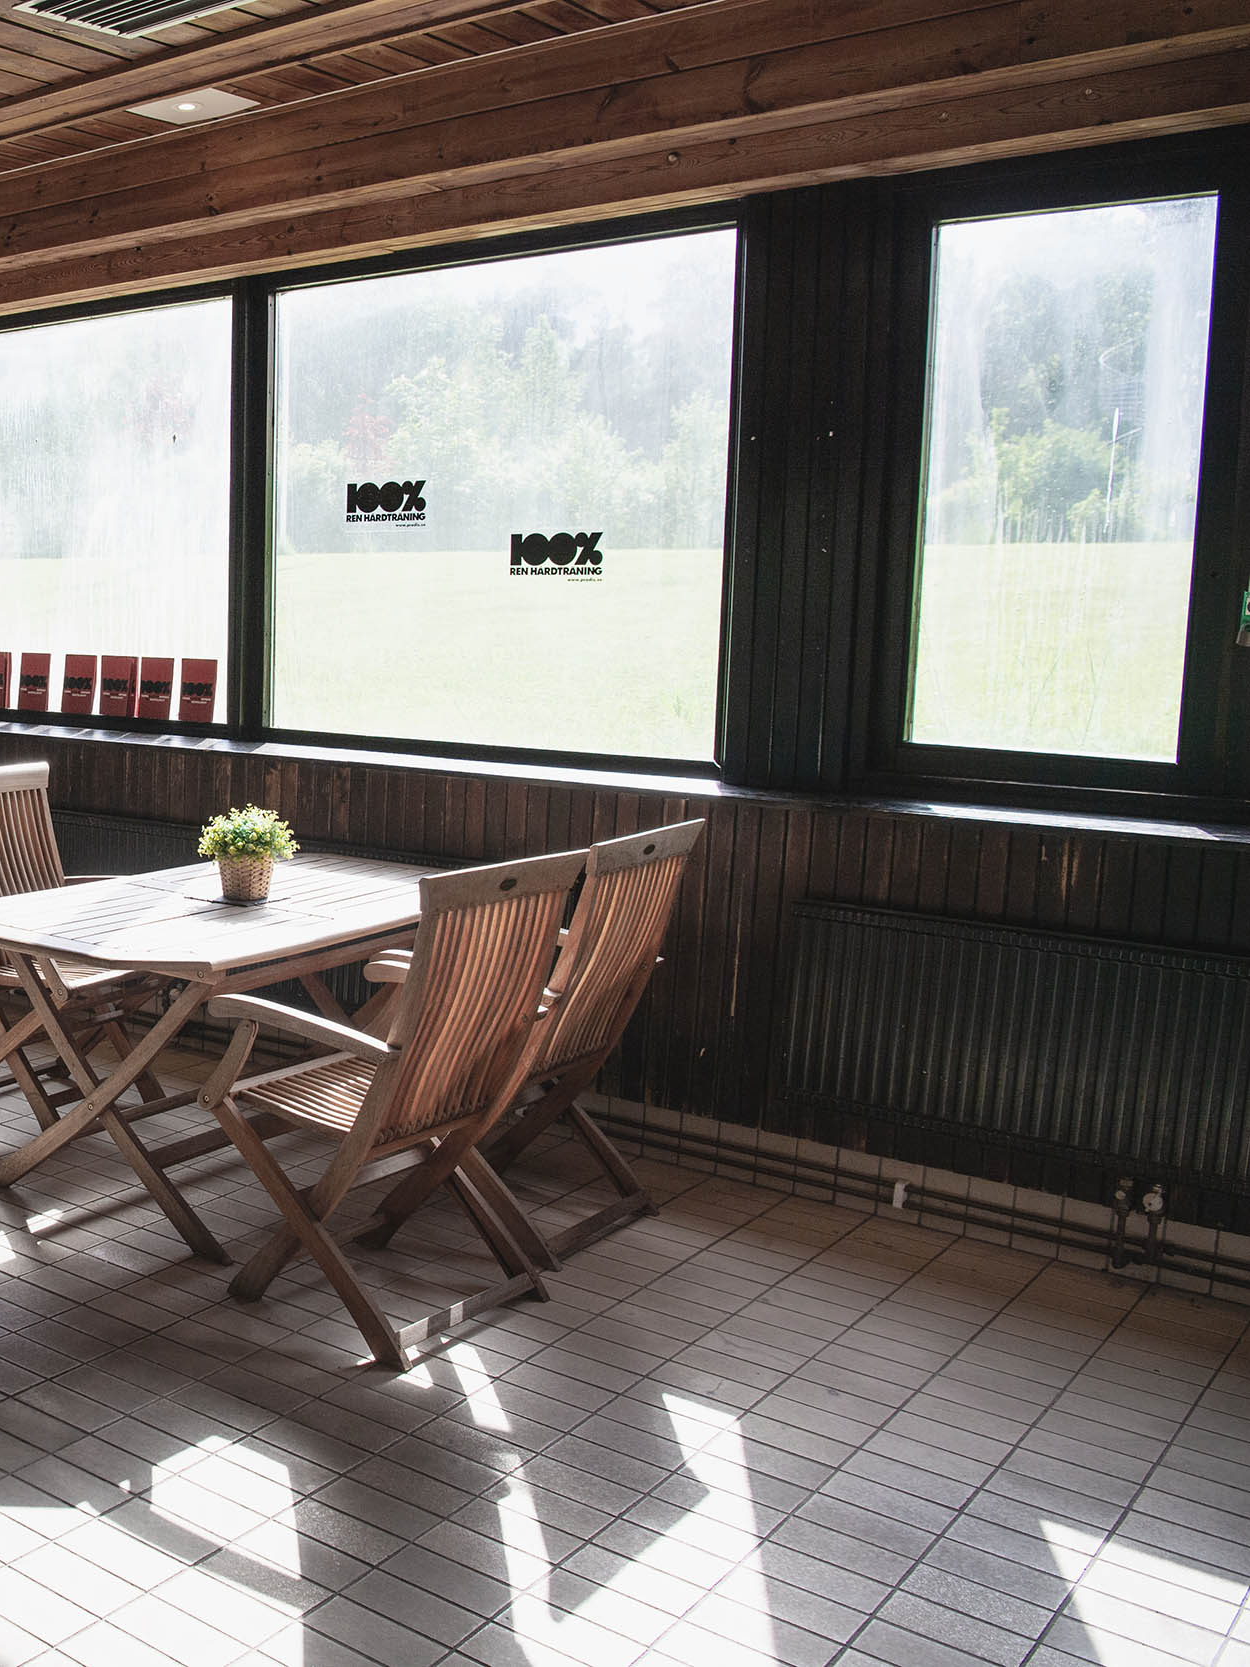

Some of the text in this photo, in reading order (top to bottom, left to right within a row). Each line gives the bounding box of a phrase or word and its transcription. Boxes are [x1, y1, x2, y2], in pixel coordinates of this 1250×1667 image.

[346, 480, 426, 513] 100%
[346, 514, 363, 522] REN
[510, 532, 603, 566] 100%
[510, 567, 528, 576] REN
